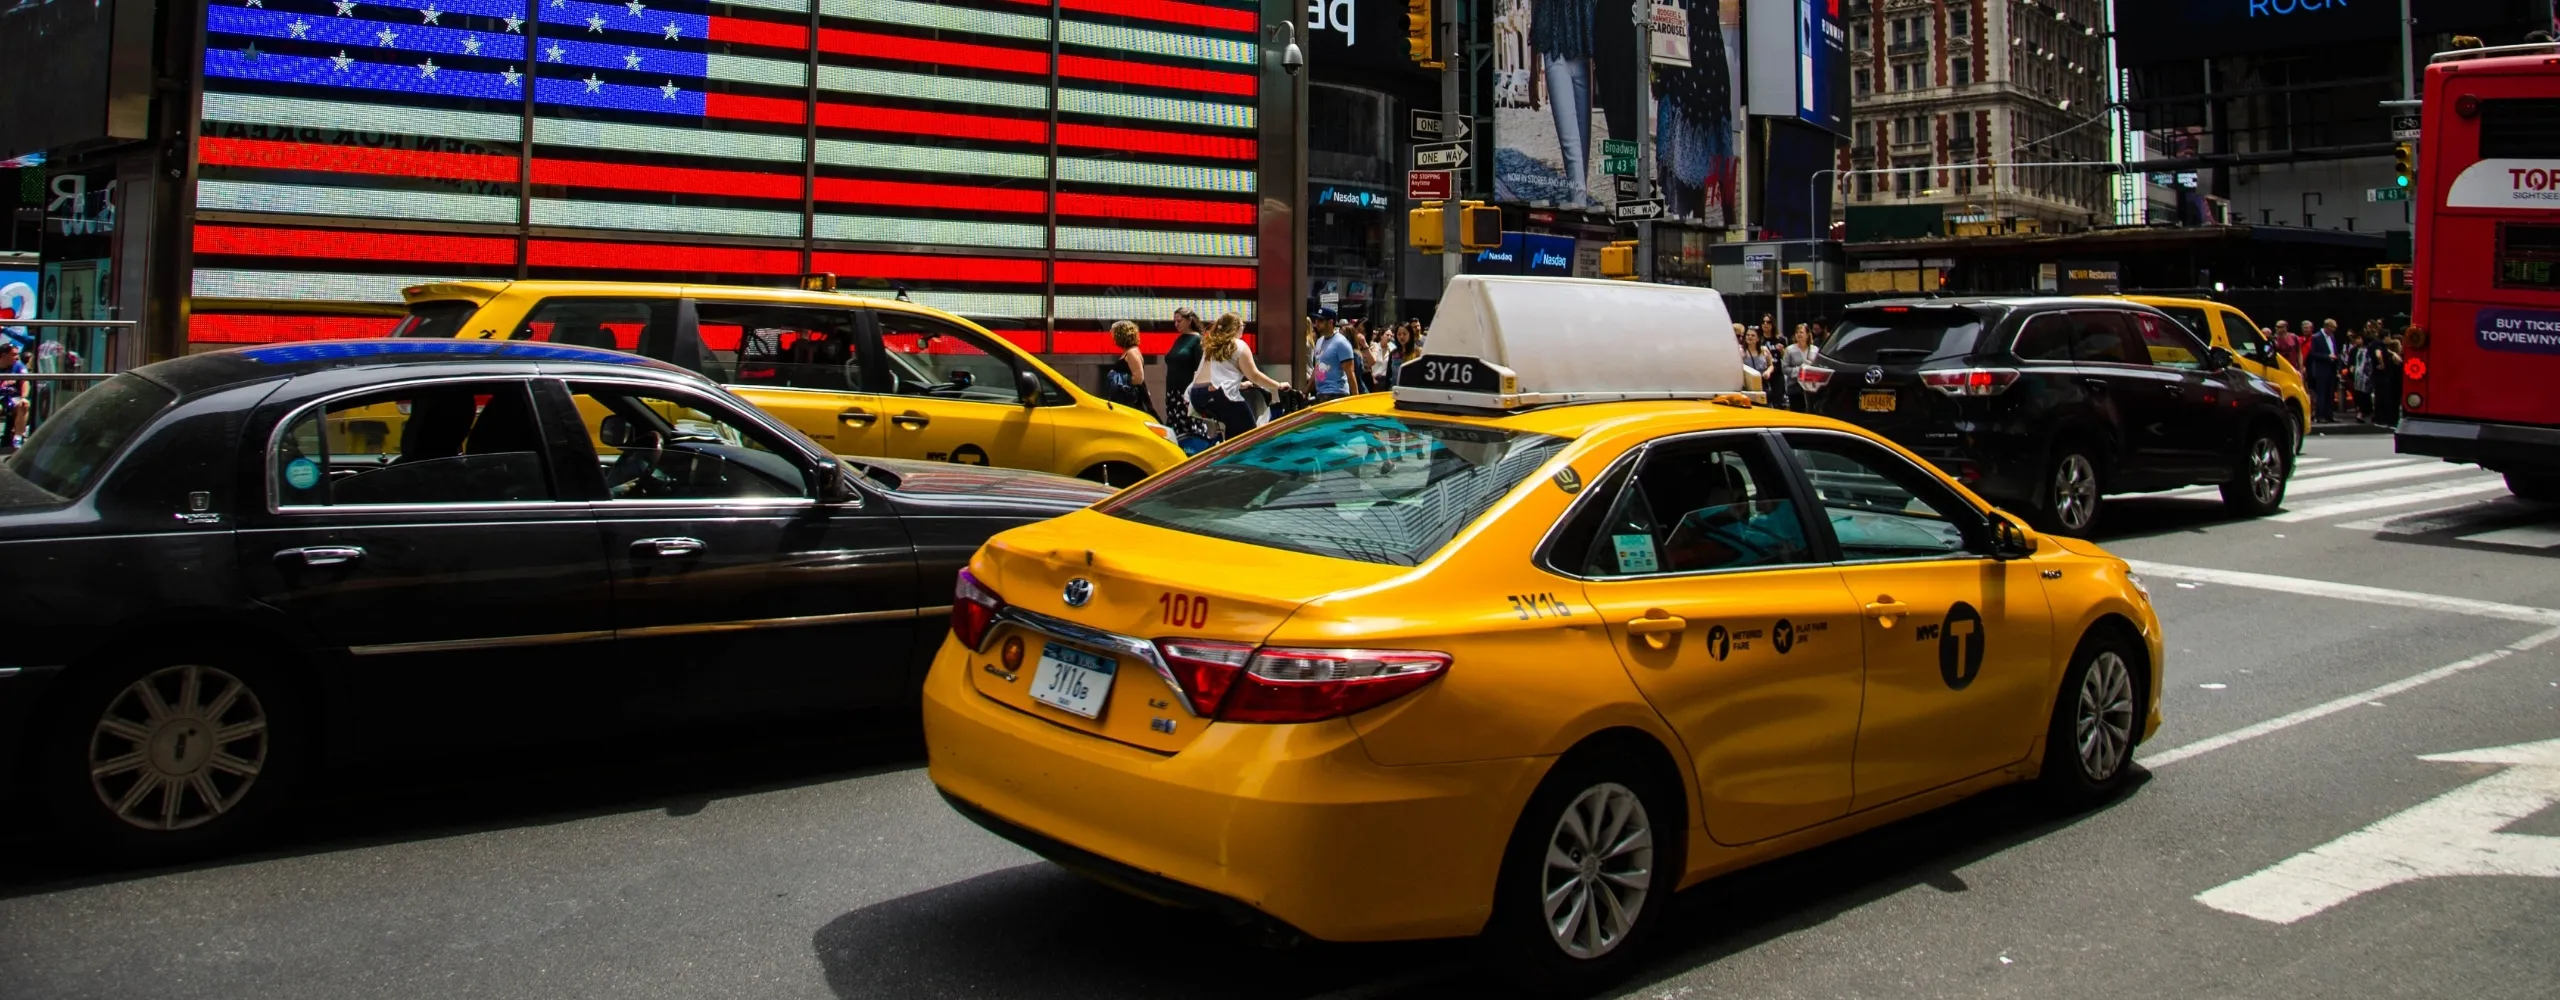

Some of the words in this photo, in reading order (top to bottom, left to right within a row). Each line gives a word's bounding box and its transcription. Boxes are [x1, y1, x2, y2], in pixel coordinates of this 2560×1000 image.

[1421, 120, 1438, 131] ONE
[1605, 141, 1637, 158] Broadway
[1422, 152, 1438, 163] ONE
[1445, 151, 1463, 162] WAY
[1606, 160, 1614, 172] W
[1617, 160, 1627, 171] 43
[1528, 174, 1547, 185] STORES
[1623, 182, 1635, 191] ONE
[1333, 191, 1360, 206] Nasdaq
[1622, 206, 1636, 216] ONE
[1642, 205, 1657, 214] WAY
[1488, 252, 1512, 262] Nasdaq
[1543, 253, 1567, 269] Nasdaq
[2496, 318, 2522, 329] BUY
[2481, 330, 2560, 345] TOPVIEWNY
[1424, 361, 1473, 384] 3Y16
[1159, 592, 1209, 629] 100
[1507, 592, 1572, 621] 3Y16
[1916, 624, 1940, 641] NYC
[1733, 641, 1750, 651] FARE
